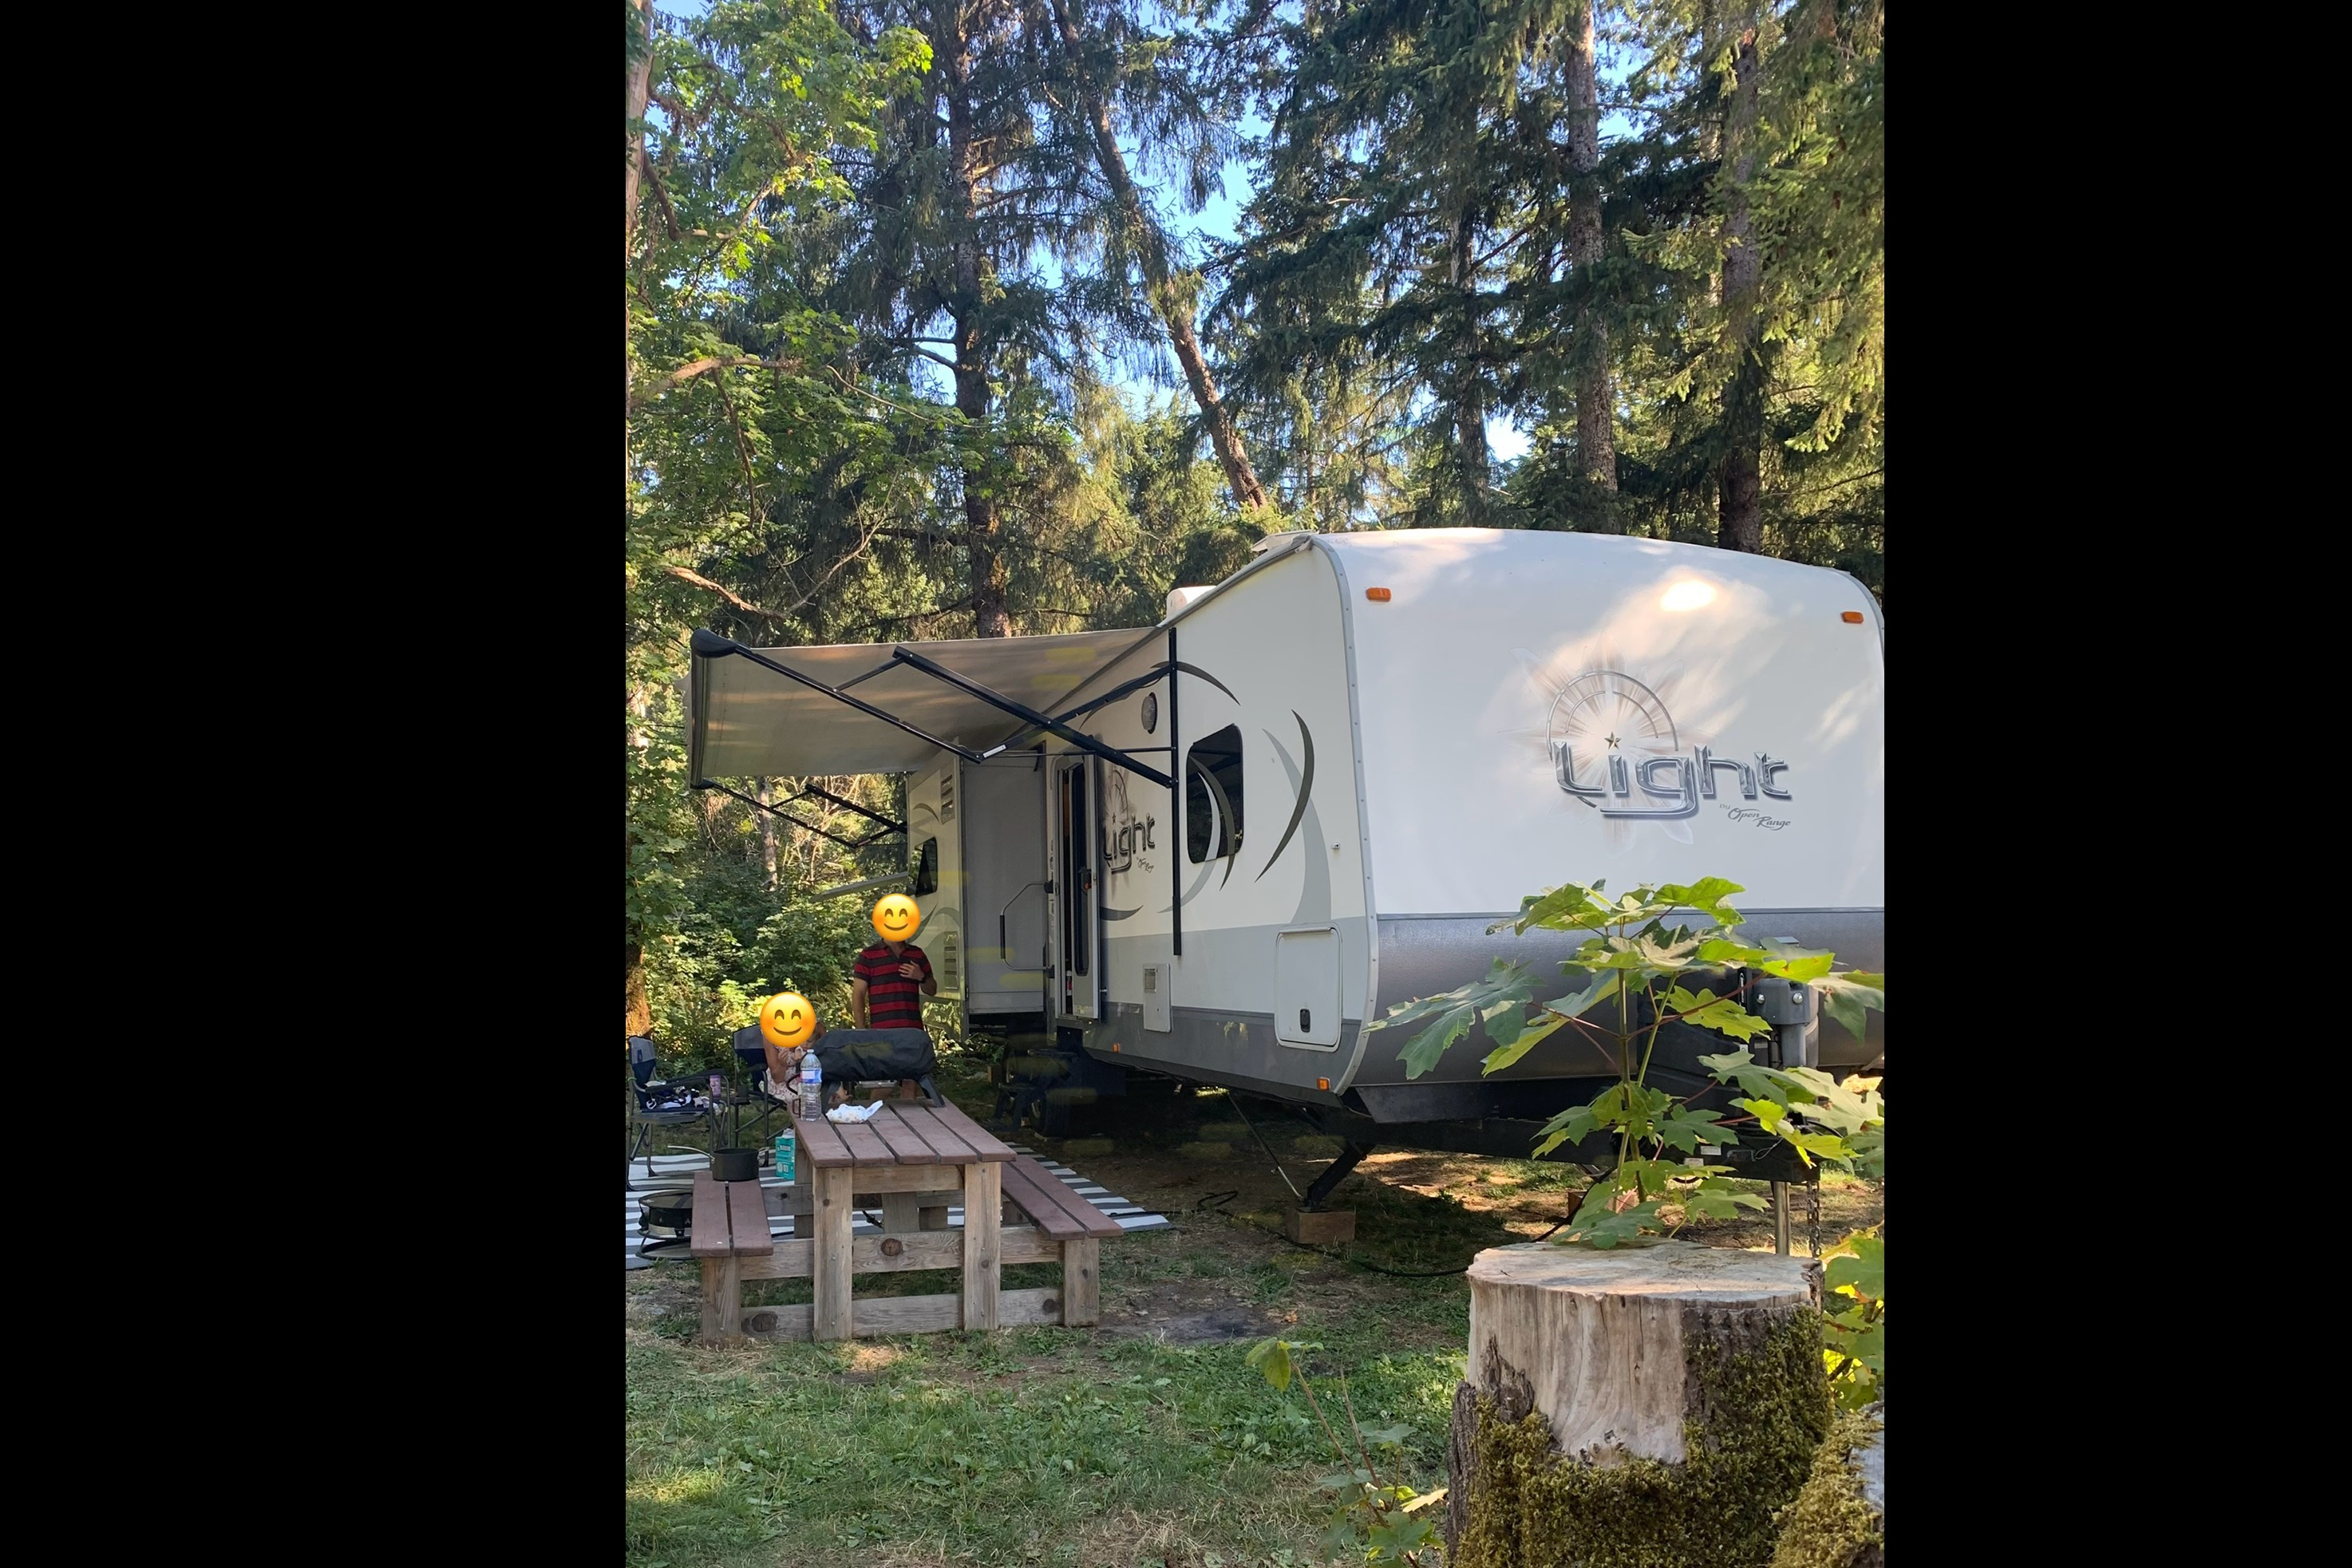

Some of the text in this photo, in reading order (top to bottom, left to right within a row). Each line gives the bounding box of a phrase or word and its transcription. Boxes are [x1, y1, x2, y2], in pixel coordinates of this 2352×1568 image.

[1553, 741, 1792, 818] Light
[1728, 808, 1761, 823] Open
[1753, 816, 1791, 831] Range
[1104, 813, 1155, 874] Light
